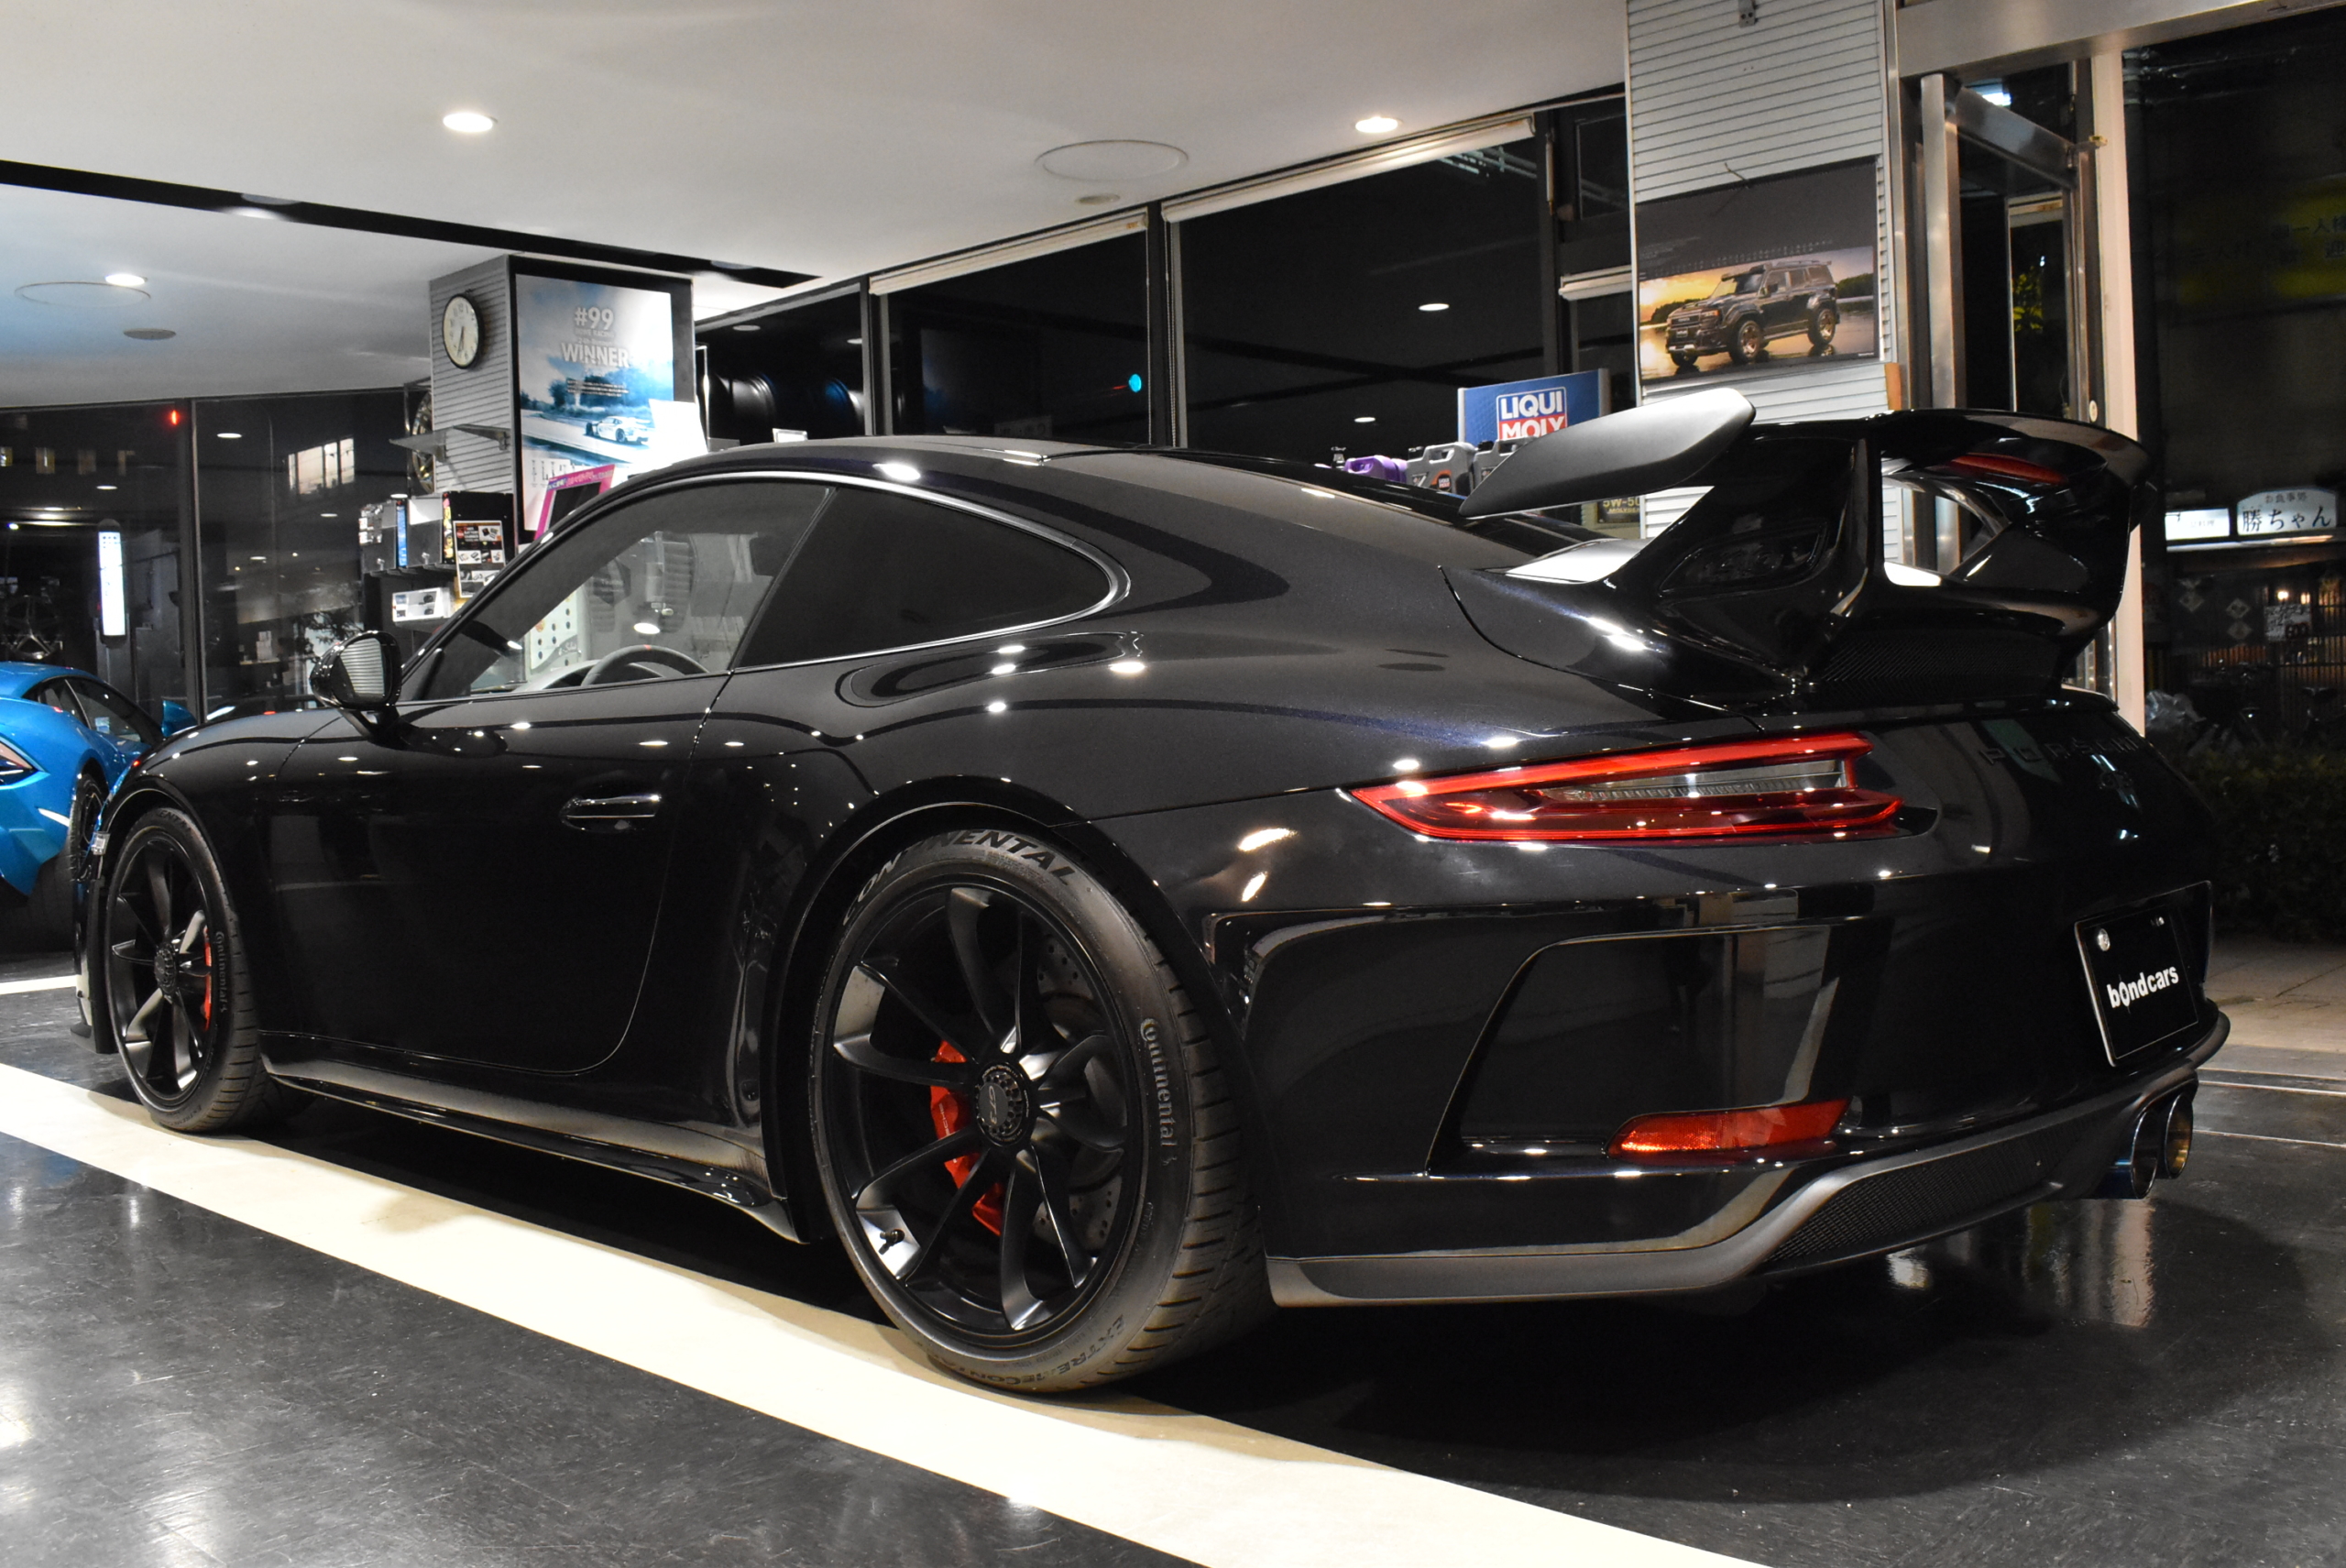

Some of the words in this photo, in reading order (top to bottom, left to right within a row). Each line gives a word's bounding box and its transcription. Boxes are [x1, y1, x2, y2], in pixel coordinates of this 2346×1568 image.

[575, 306, 614, 331] #99
[561, 342, 630, 368] WINNER
[1500, 390, 1562, 420] LIQUI
[1501, 415, 1565, 440] MOLY
[2242, 505, 2331, 532] 勝ちゃん
[2107, 966, 2179, 1008] bondcars
[1140, 1018, 1178, 1146] Continental
